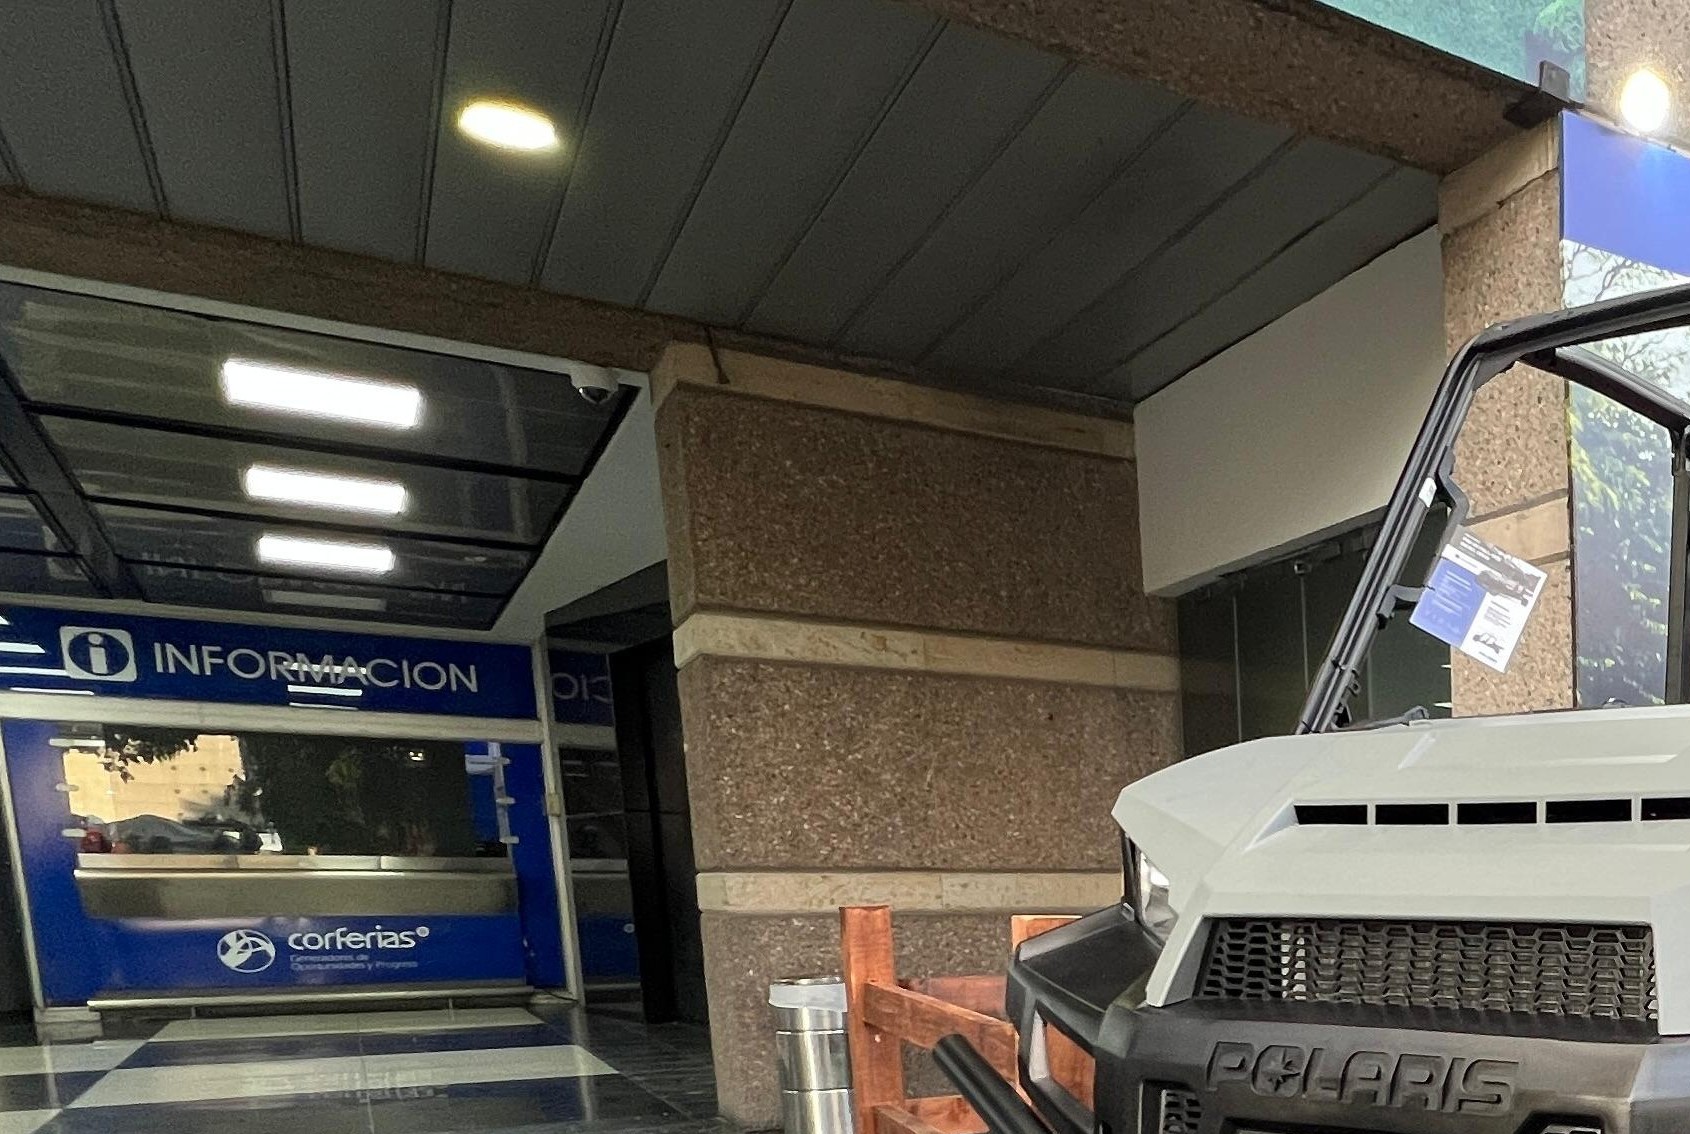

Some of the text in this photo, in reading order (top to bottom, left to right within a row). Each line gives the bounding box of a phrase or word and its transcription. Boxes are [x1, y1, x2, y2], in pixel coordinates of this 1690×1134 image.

[153, 642, 479, 693] INFORMACION
[288, 924, 416, 950] corferias
[1207, 1041, 1521, 1116] POLARIS
